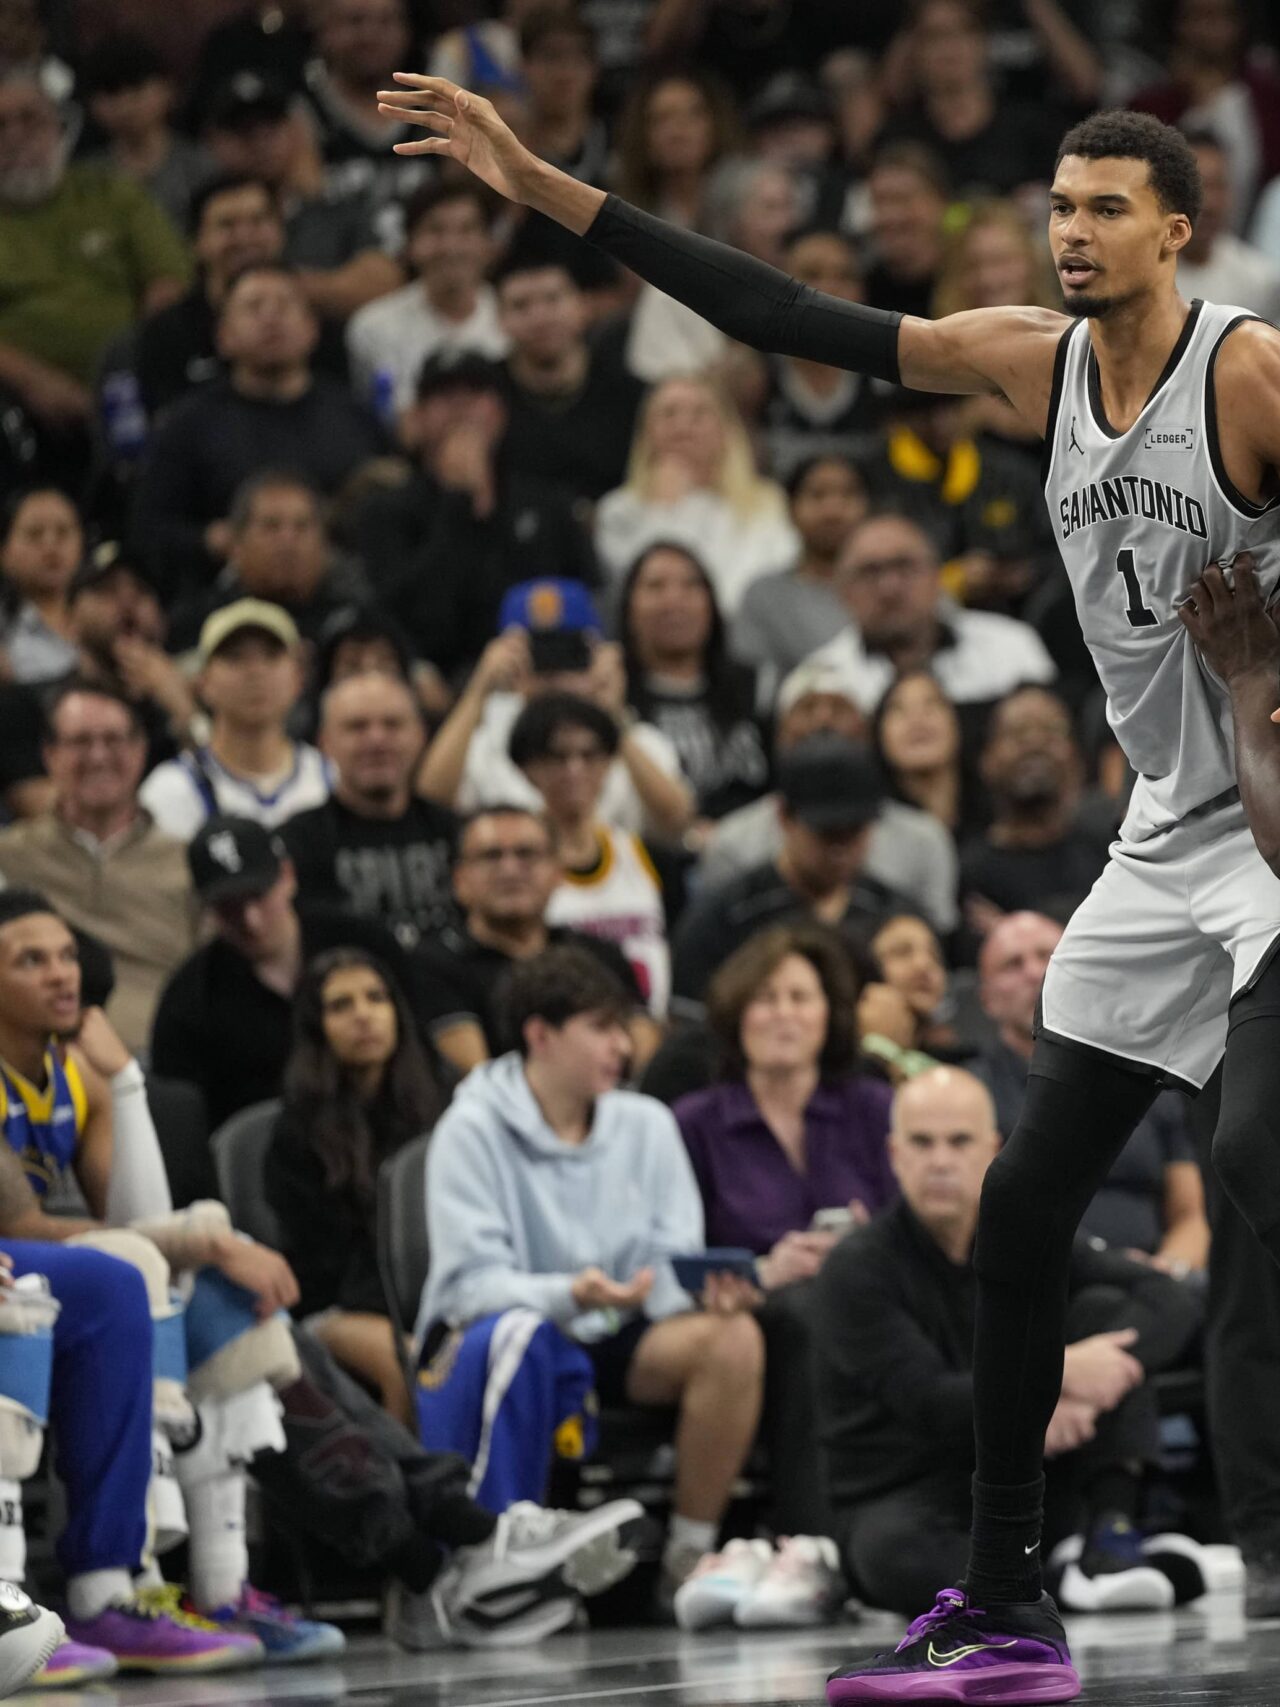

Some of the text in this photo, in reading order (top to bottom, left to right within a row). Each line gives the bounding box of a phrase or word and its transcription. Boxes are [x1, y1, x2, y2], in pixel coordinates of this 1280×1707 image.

[1149, 433, 1188, 444] LEDGER
[1090, 475, 1209, 541] ANTONIO
[1116, 547, 1161, 628] 1
